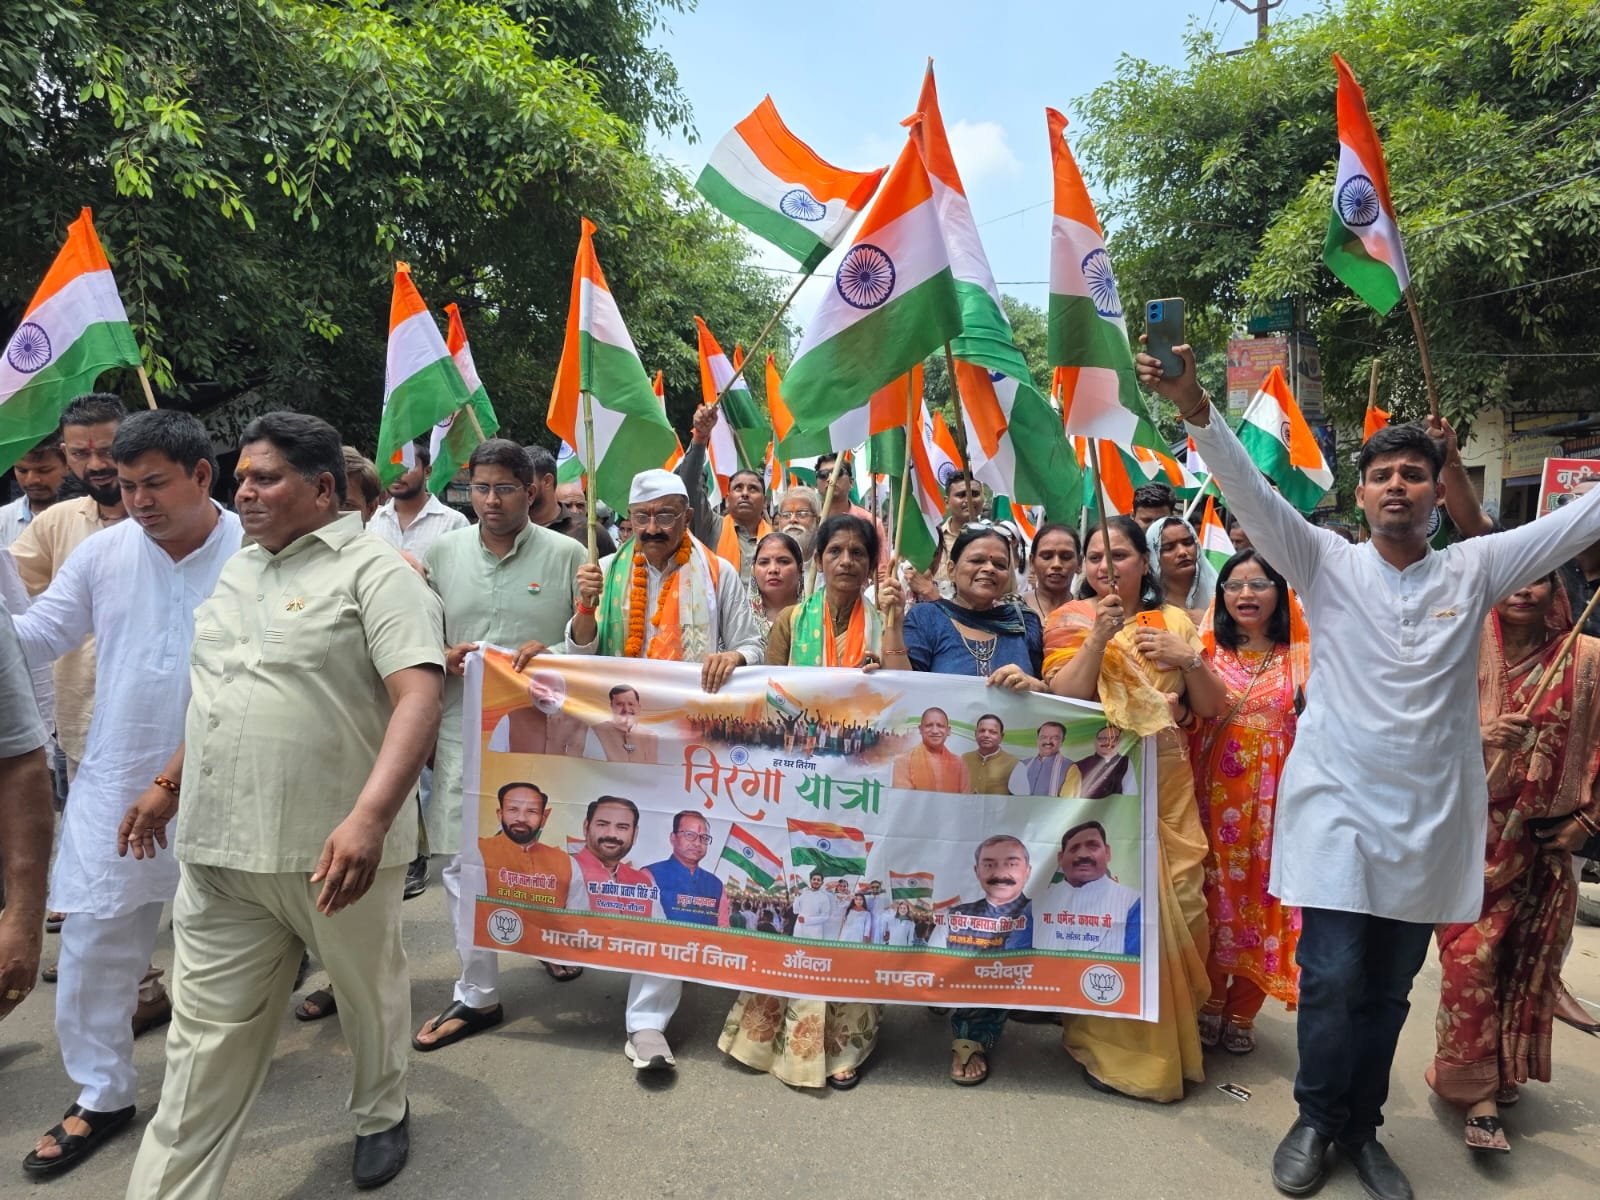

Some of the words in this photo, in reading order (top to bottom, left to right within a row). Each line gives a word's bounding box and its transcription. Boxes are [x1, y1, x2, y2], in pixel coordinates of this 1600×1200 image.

[795, 759, 817, 771] तिरंगा
[681, 744, 786, 821] तिरंगा
[795, 772, 885, 815] यात्रा
[649, 886, 659, 900] जी
[1101, 912, 1112, 929] जी
[540, 927, 604, 950] भारतीय
[607, 936, 657, 958] जनता
[660, 940, 700, 964] पार्टी
[702, 944, 748, 971] जिला
[782, 949, 833, 973] आँवला
[874, 969, 935, 988] मण्डल
[974, 960, 1034, 986] फरीदपुर
